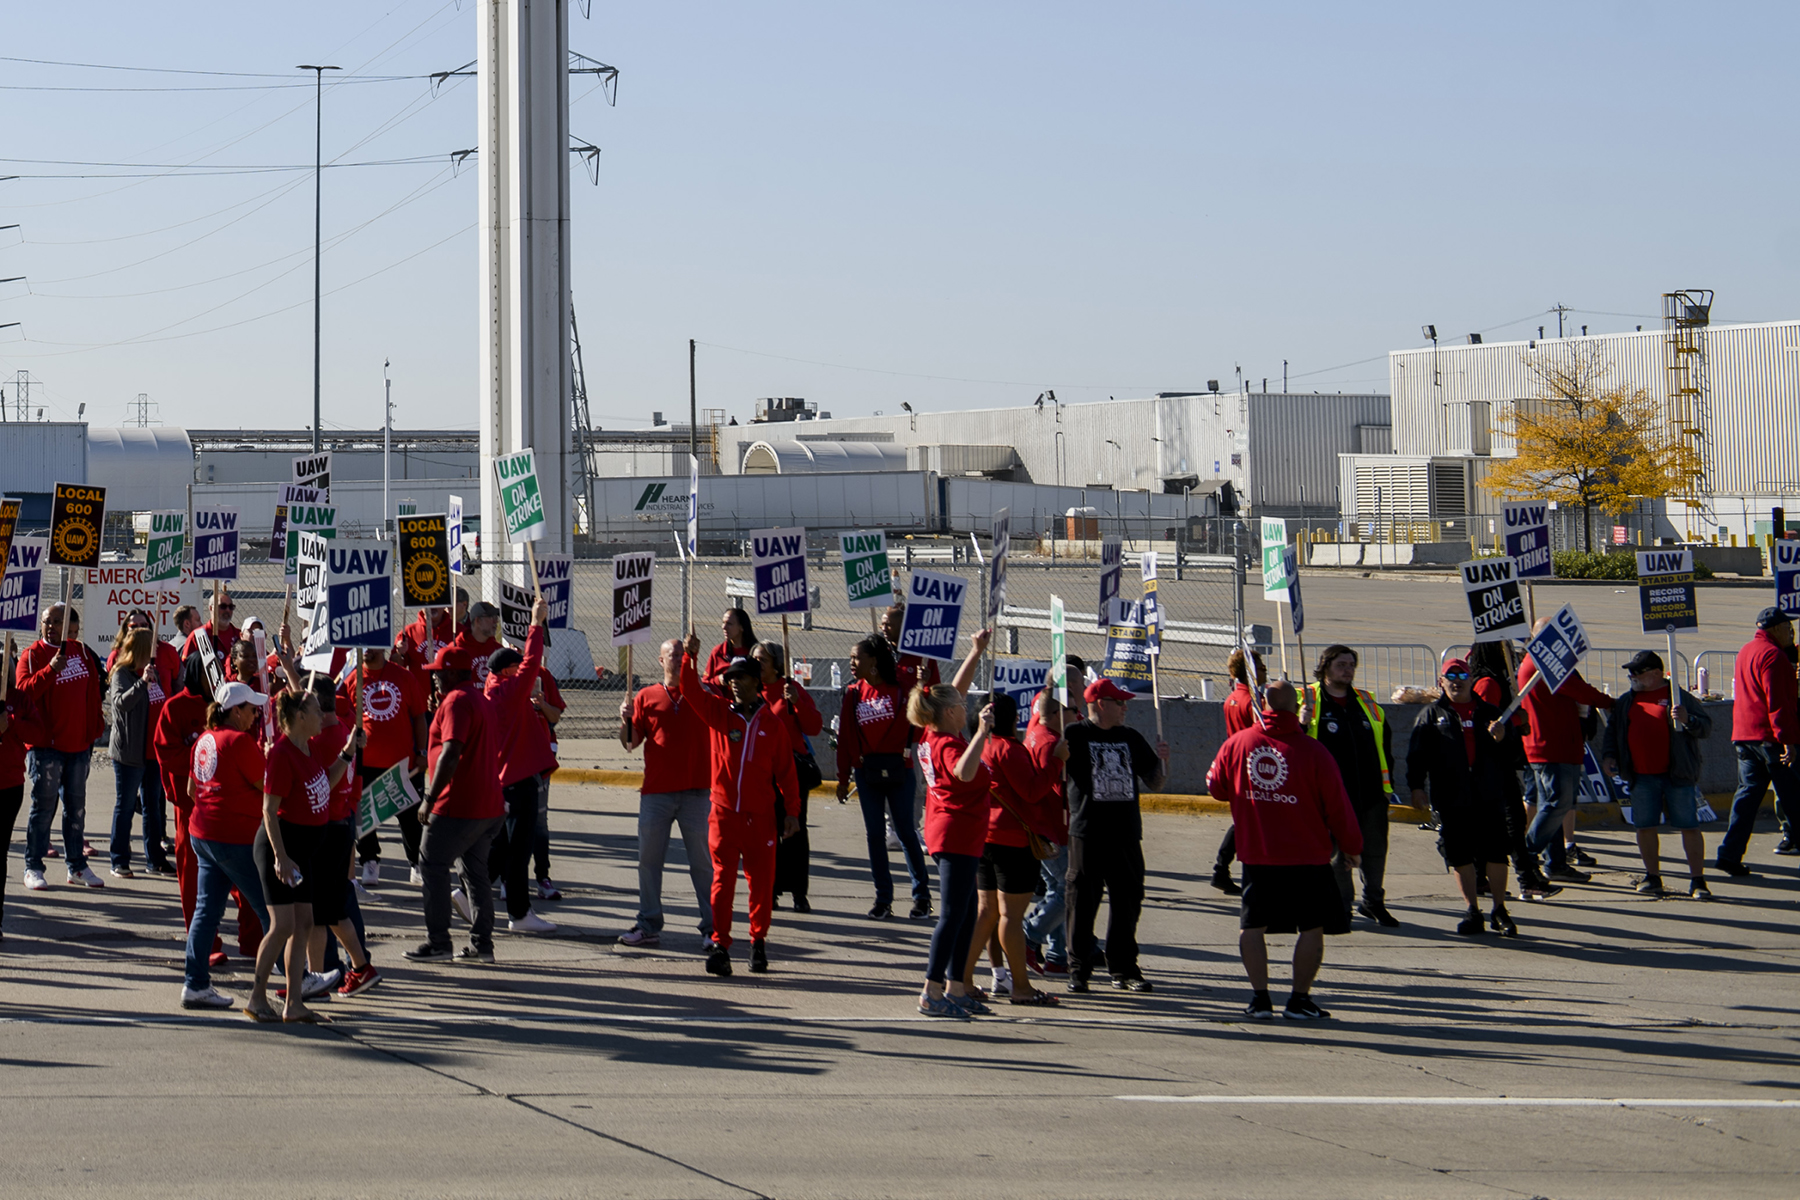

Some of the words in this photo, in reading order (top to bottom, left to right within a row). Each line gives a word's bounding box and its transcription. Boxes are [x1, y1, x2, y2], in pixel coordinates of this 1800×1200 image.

[296, 456, 328, 477] UAW
[500, 454, 532, 479] UAW
[57, 487, 103, 501] LOCAL
[511, 482, 527, 506] ON
[0, 505, 18, 519] LOCAL
[66, 503, 92, 515] 600
[291, 506, 336, 525] UAW
[508, 492, 541, 533] STRIKE
[1505, 506, 1545, 526] UAW
[0, 524, 12, 537] 600
[153, 514, 184, 532] UAW
[196, 512, 237, 530] UAW
[400, 519, 445, 533] LOCAL
[157, 539, 173, 558] ON
[208, 536, 224, 554] ON
[410, 536, 436, 548] 600
[755, 535, 800, 558] UAW
[843, 533, 882, 554] UAW
[1520, 532, 1536, 552] ON
[144, 550, 182, 581] STRIKE
[196, 551, 236, 575] STRIKE
[329, 549, 388, 575] UAW
[616, 558, 651, 580] UAW
[856, 559, 874, 579] ON
[1646, 553, 1683, 572] UAW
[88, 568, 194, 584] EMERCY
[772, 563, 789, 585] ON
[1465, 561, 1511, 584] UAW
[1641, 576, 1674, 585] STAND
[1677, 574, 1690, 583] UP
[848, 569, 890, 599] STRIKE
[912, 576, 963, 603] UAW
[1650, 587, 1685, 596] RECORD
[107, 589, 180, 605] ACCESS
[348, 584, 370, 611] ON
[623, 589, 639, 611] ON
[760, 579, 805, 611] STRIKE
[1482, 587, 1503, 608] ON
[1650, 594, 1686, 603] PROFITS
[1474, 596, 1523, 633] STRIKE
[1644, 609, 1695, 620] CONTRACTS
[1650, 603, 1686, 612] RECORD
[118, 610, 170, 625] PNT
[331, 605, 388, 642] STRIKE
[613, 601, 652, 636] STRIKE
[922, 608, 943, 627] ON
[904, 626, 955, 646] STRIKE
[1112, 628, 1142, 637] STAND
[1558, 609, 1587, 656] UAW
[1113, 651, 1149, 661] PROFITS
[1551, 639, 1569, 660] ON
[1111, 661, 1147, 671] RECORD
[1531, 640, 1567, 681] STRIKE
[1009, 668, 1047, 684] UAW
[1103, 669, 1153, 680] CONTRACTS
[1258, 763, 1277, 775] UAW
[1273, 793, 1297, 804] 900
